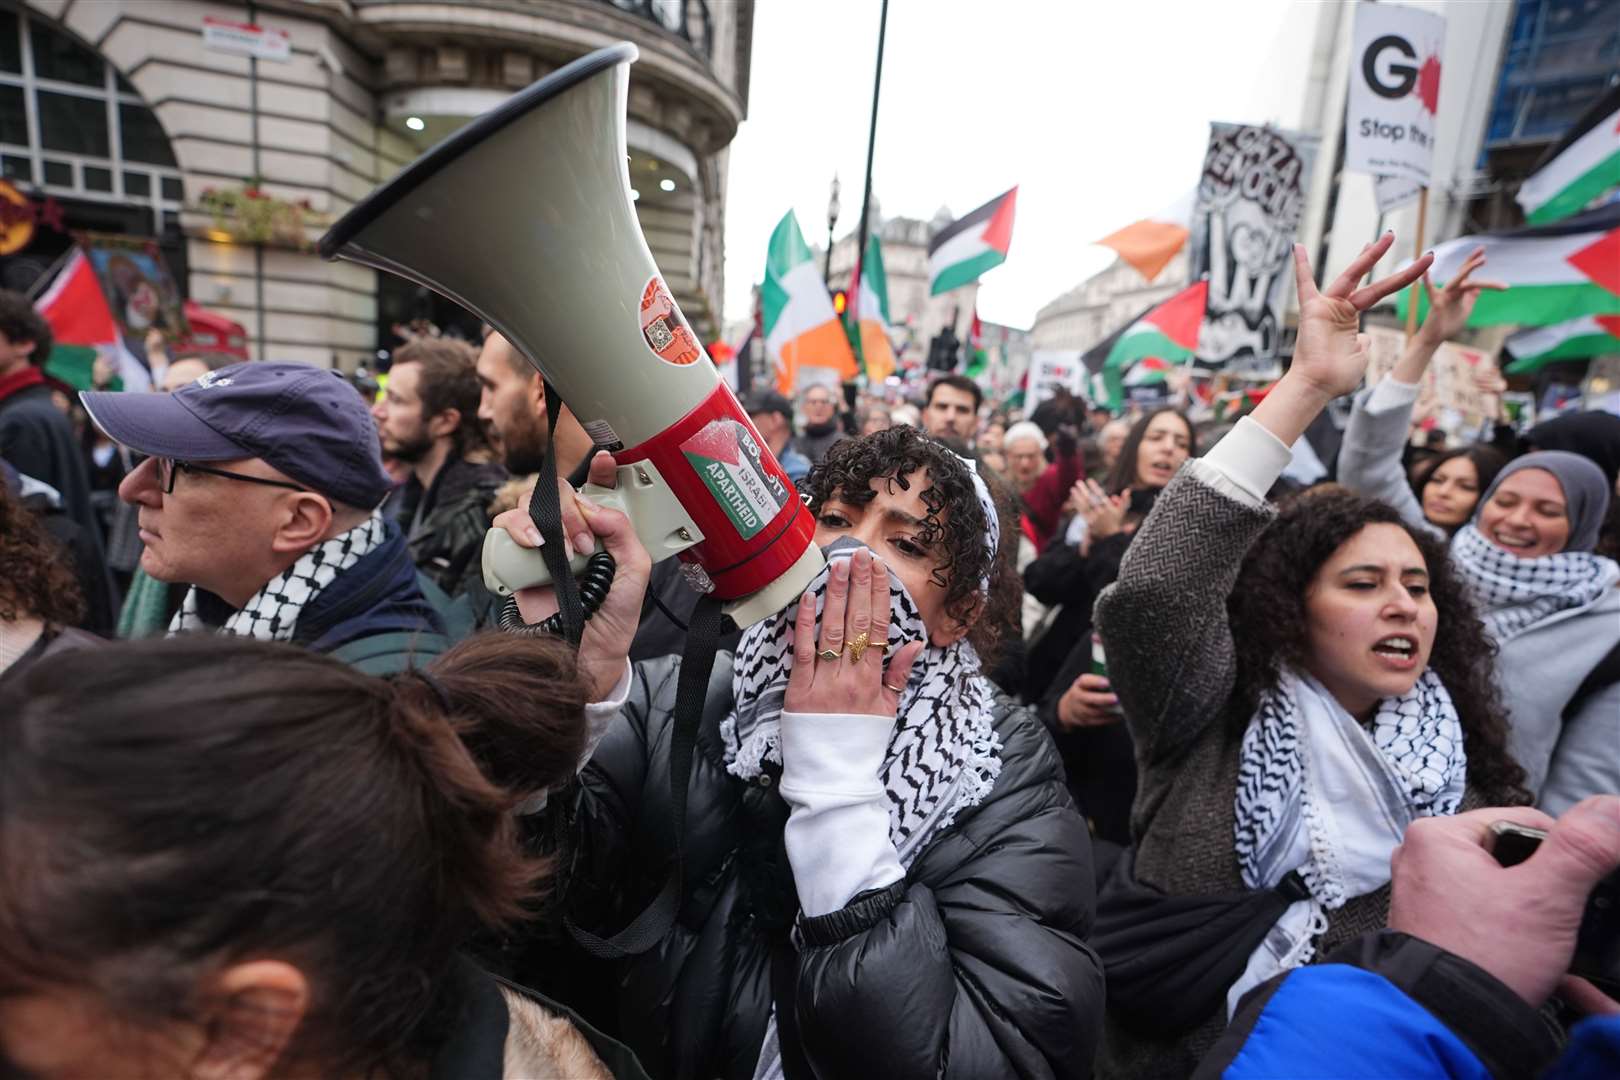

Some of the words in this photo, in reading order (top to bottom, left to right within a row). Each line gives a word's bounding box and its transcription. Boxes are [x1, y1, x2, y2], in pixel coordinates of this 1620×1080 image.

[1235, 127, 1300, 190] GAZA
[1360, 117, 1405, 142] Stop
[706, 462, 757, 528] APARTHEID
